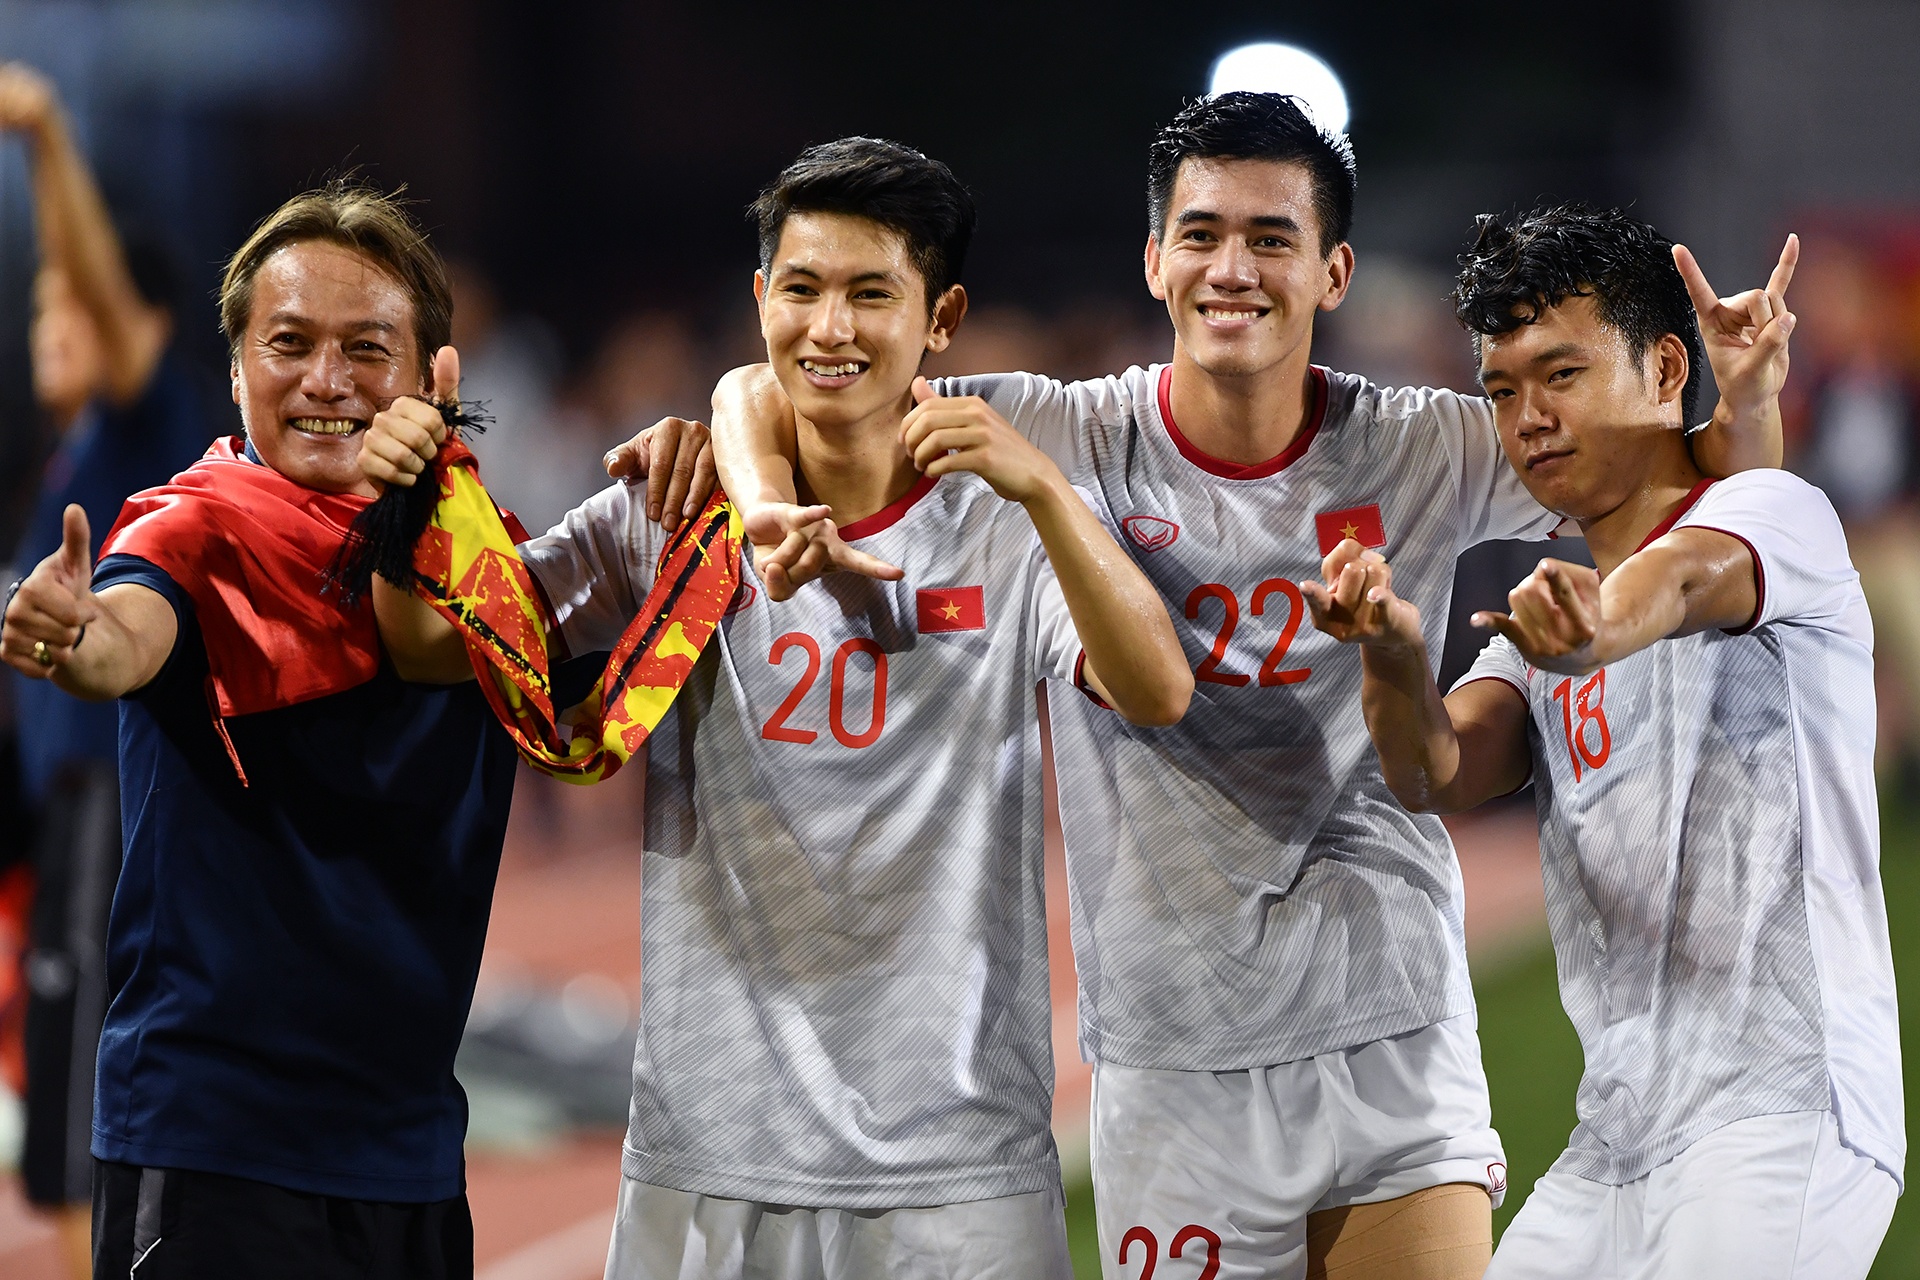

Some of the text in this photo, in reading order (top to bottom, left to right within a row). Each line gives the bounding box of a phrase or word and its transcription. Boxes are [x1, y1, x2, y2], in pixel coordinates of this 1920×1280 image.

[1185, 577, 1312, 688] 22
[761, 631, 889, 749] 20
[1552, 666, 1612, 784] 18
[1118, 1223, 1222, 1280] 22
